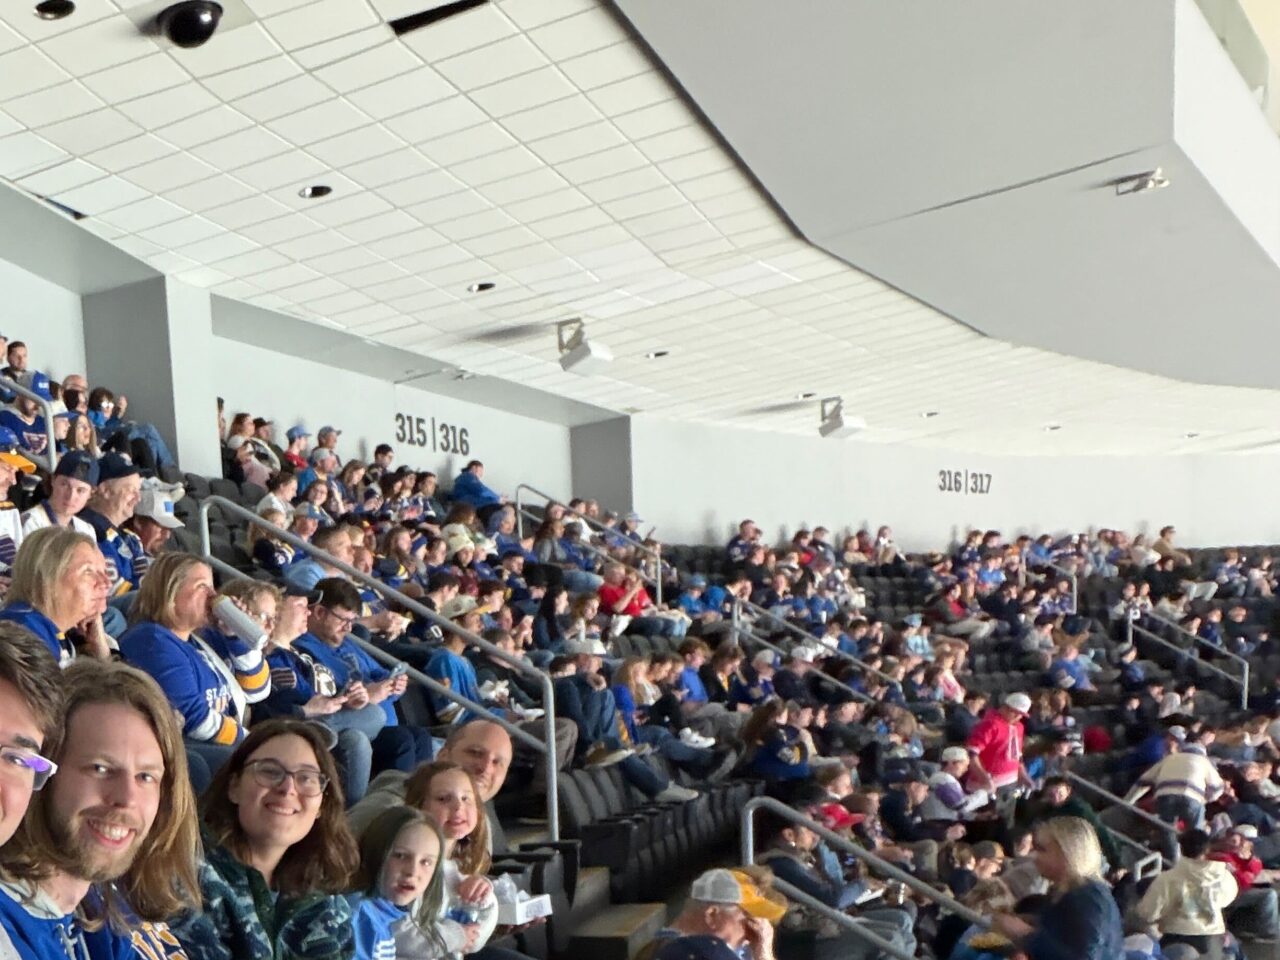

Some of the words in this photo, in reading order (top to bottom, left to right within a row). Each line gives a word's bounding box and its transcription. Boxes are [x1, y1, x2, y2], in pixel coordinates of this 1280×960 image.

[395, 411, 427, 447] 315
[439, 422, 470, 456] 316
[938, 469, 962, 493] 316
[970, 472, 992, 494] 317
